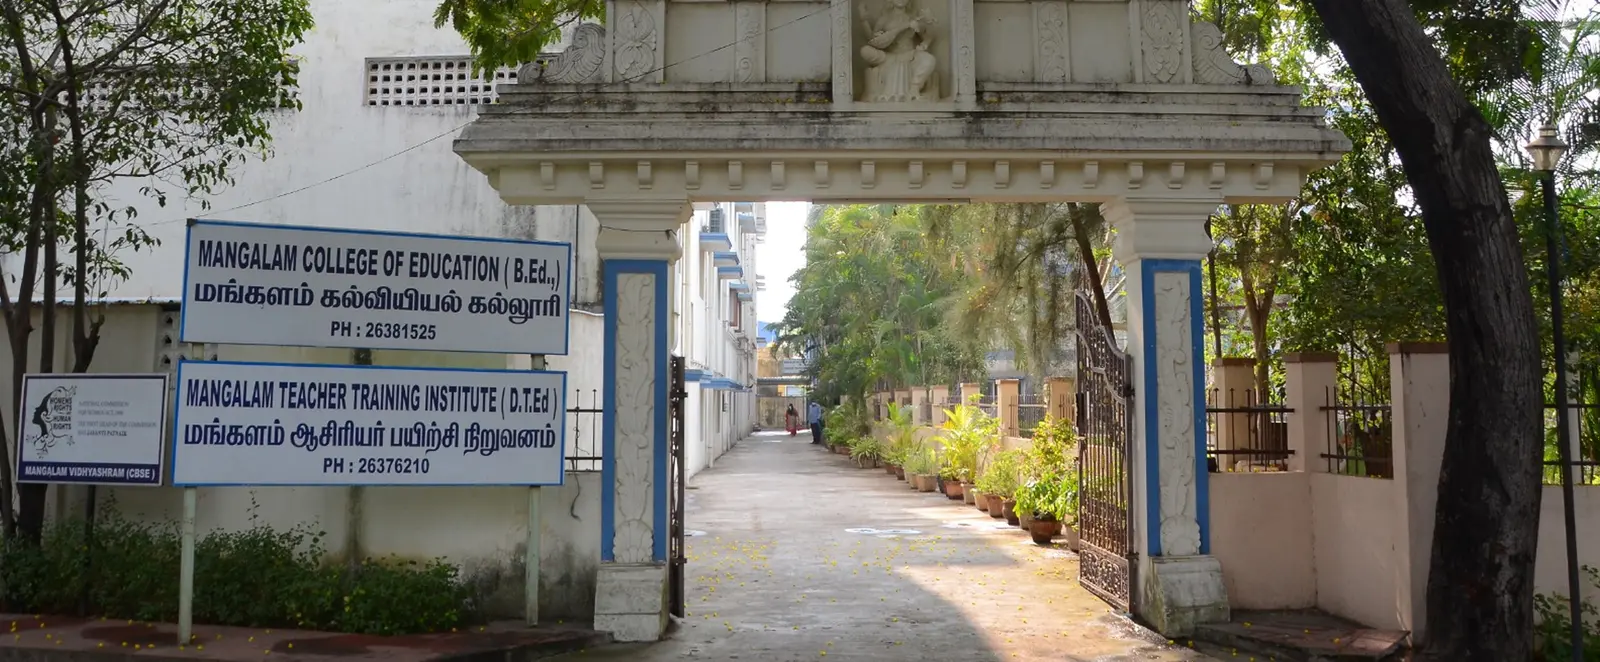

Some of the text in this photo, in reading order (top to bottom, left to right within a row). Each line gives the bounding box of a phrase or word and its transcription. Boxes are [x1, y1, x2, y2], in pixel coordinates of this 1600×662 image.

[199, 240, 297, 271] MANGALAM
[303, 246, 378, 275] COLLEGE
[384, 250, 404, 276] OF
[409, 252, 499, 281] EDUCATION
[195, 278, 560, 324] மங்களம் கல்வியியல் கல்லூரி
[331, 321, 351, 336] PH
[366, 323, 435, 340] 26381525
[187, 379, 274, 408] MANGALAM
[279, 382, 346, 409] TEACHER
[352, 384, 420, 411] TRAINING
[425, 386, 496, 412] INSTITUTE
[510, 388, 549, 413] D.T.Ed
[185, 418, 555, 456] மங்களம் ஆசிரியர் பயிற்சி நிறுவனம்
[25, 466, 67, 476] MANGALAM
[68, 467, 125, 478] VIDHYASHRAM
[324, 458, 344, 473] PH
[358, 458, 429, 473] 26376210
